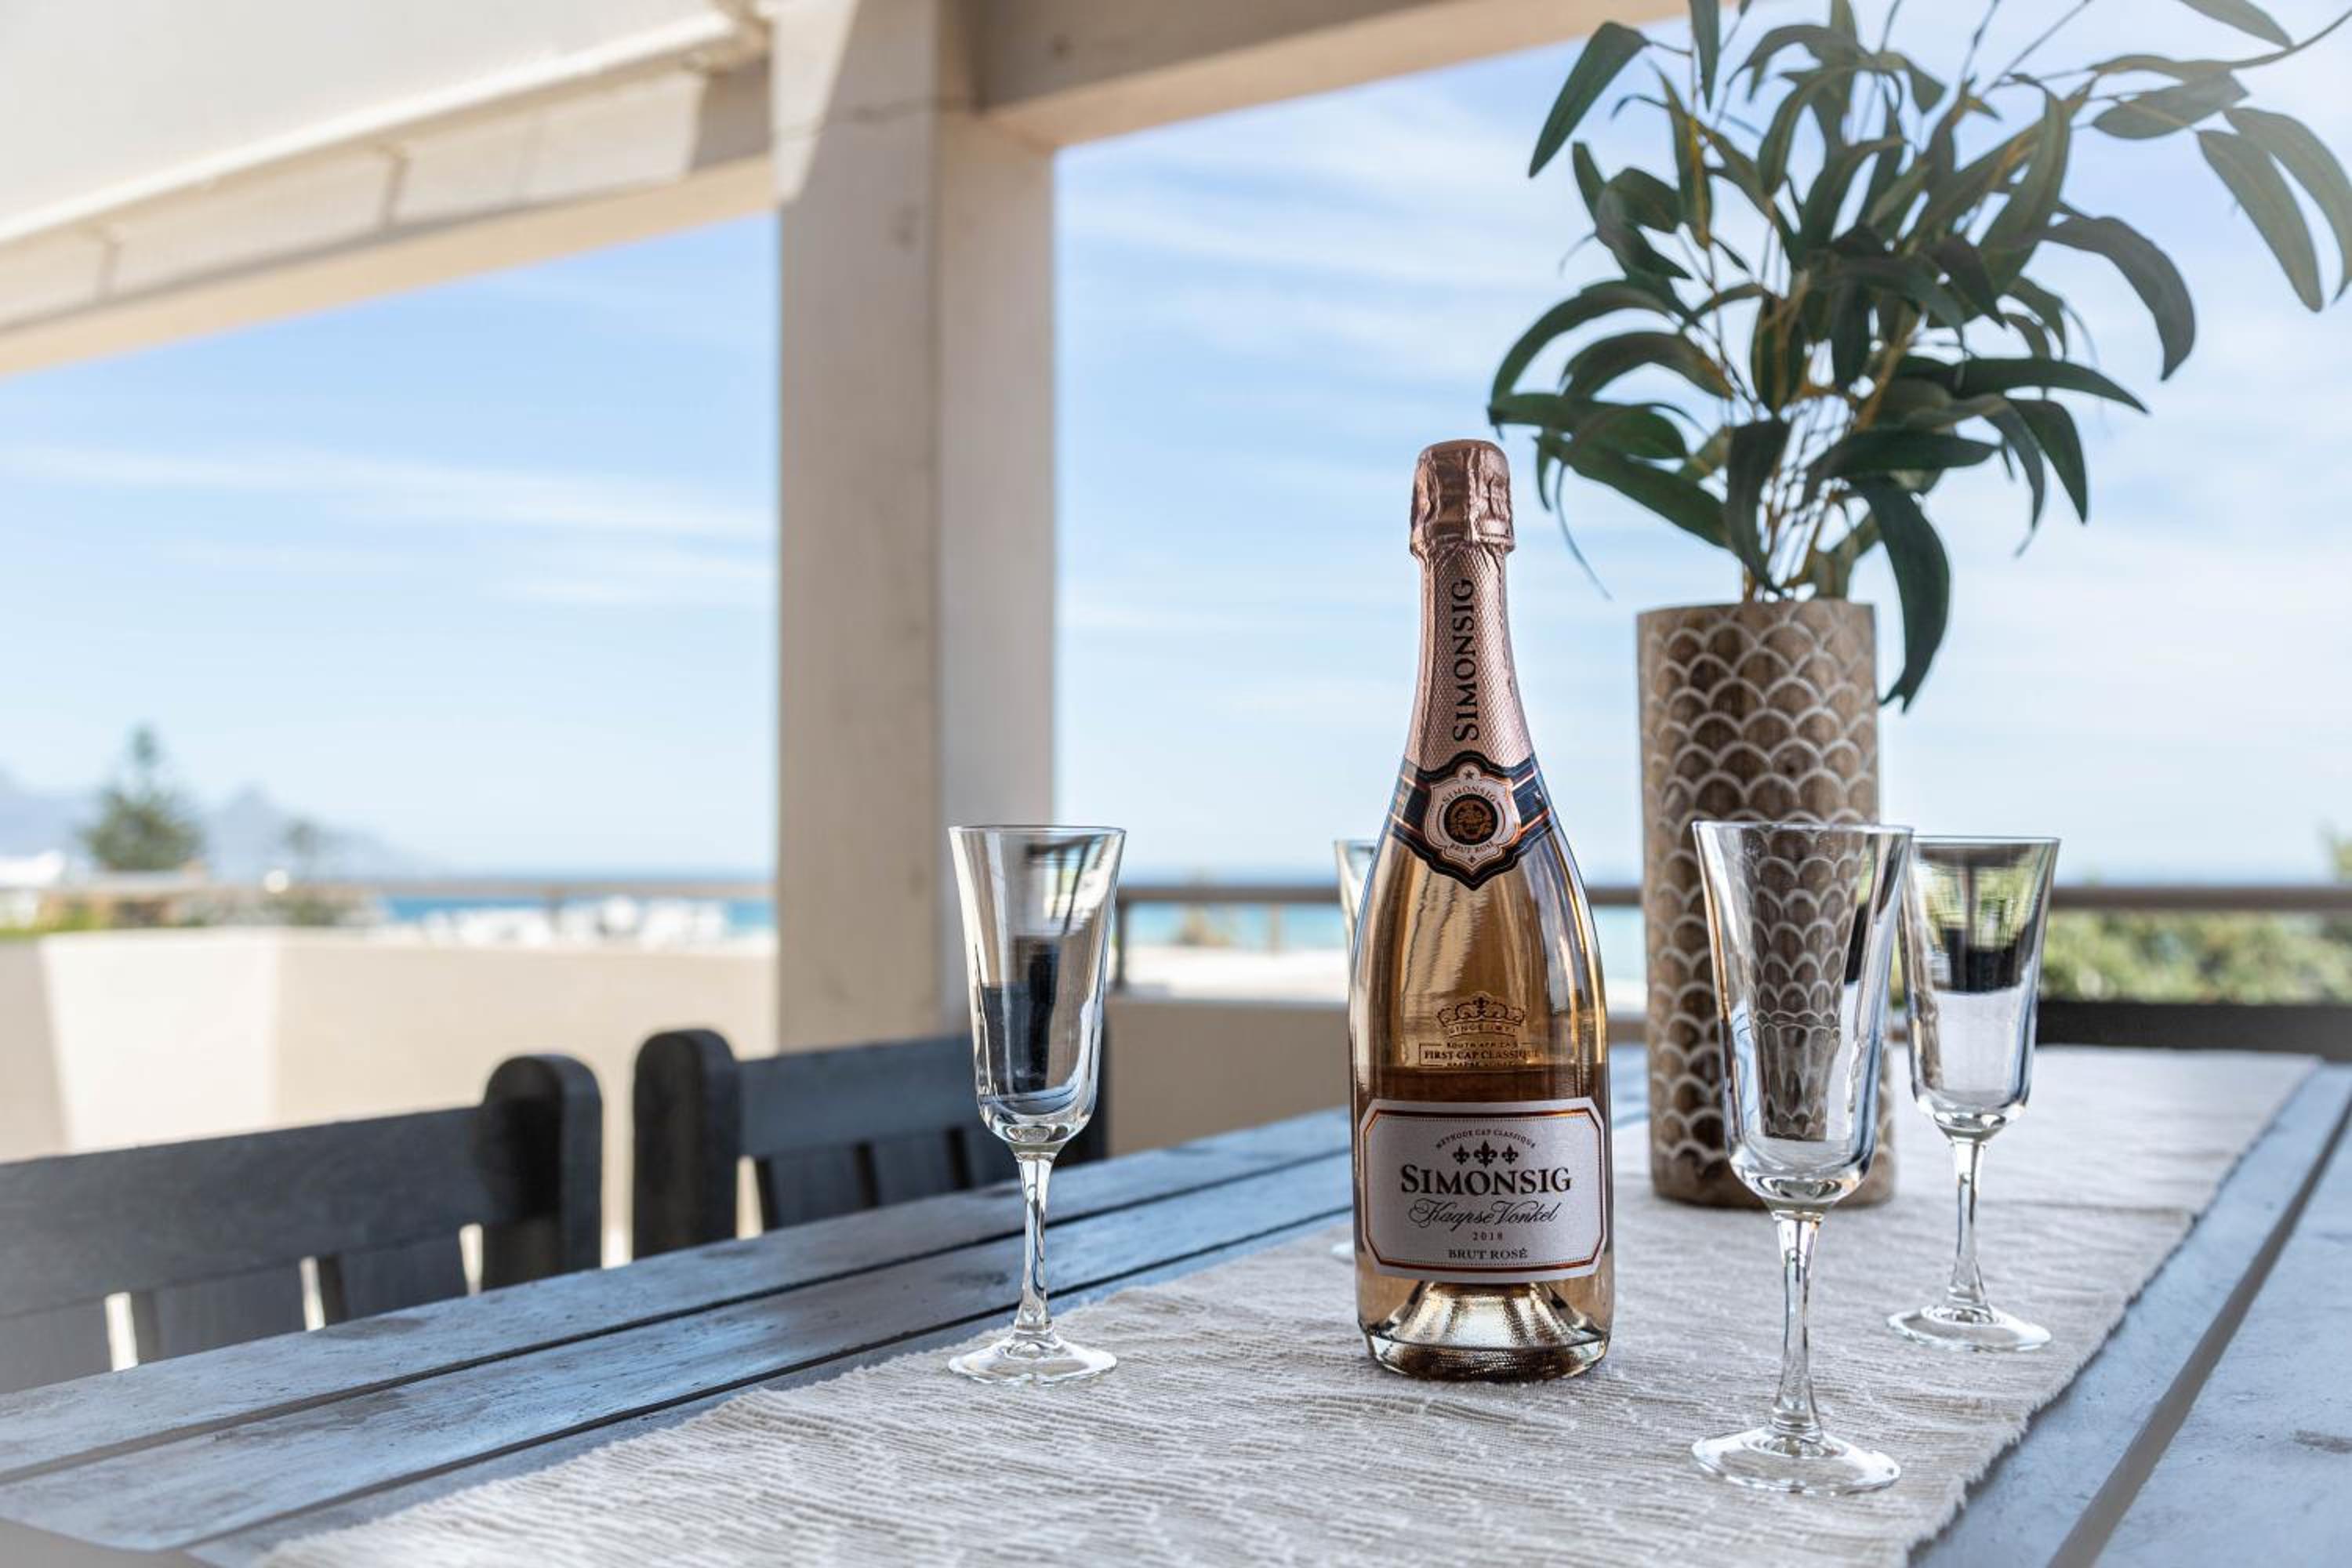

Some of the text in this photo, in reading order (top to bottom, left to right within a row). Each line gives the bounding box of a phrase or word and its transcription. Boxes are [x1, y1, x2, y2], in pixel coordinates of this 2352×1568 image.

[1452, 579, 1479, 742] SIMONSIG
[1443, 785, 1497, 804] SIMONSIG
[1425, 1051, 1454, 1059] FIRST
[1456, 1051, 1479, 1059] CAP
[1401, 1164, 1572, 1196] SIMONSIG
[1409, 1198, 1563, 1232] Kaapse Vonkel
[1449, 1247, 1528, 1259] BRUT ROSÉ
